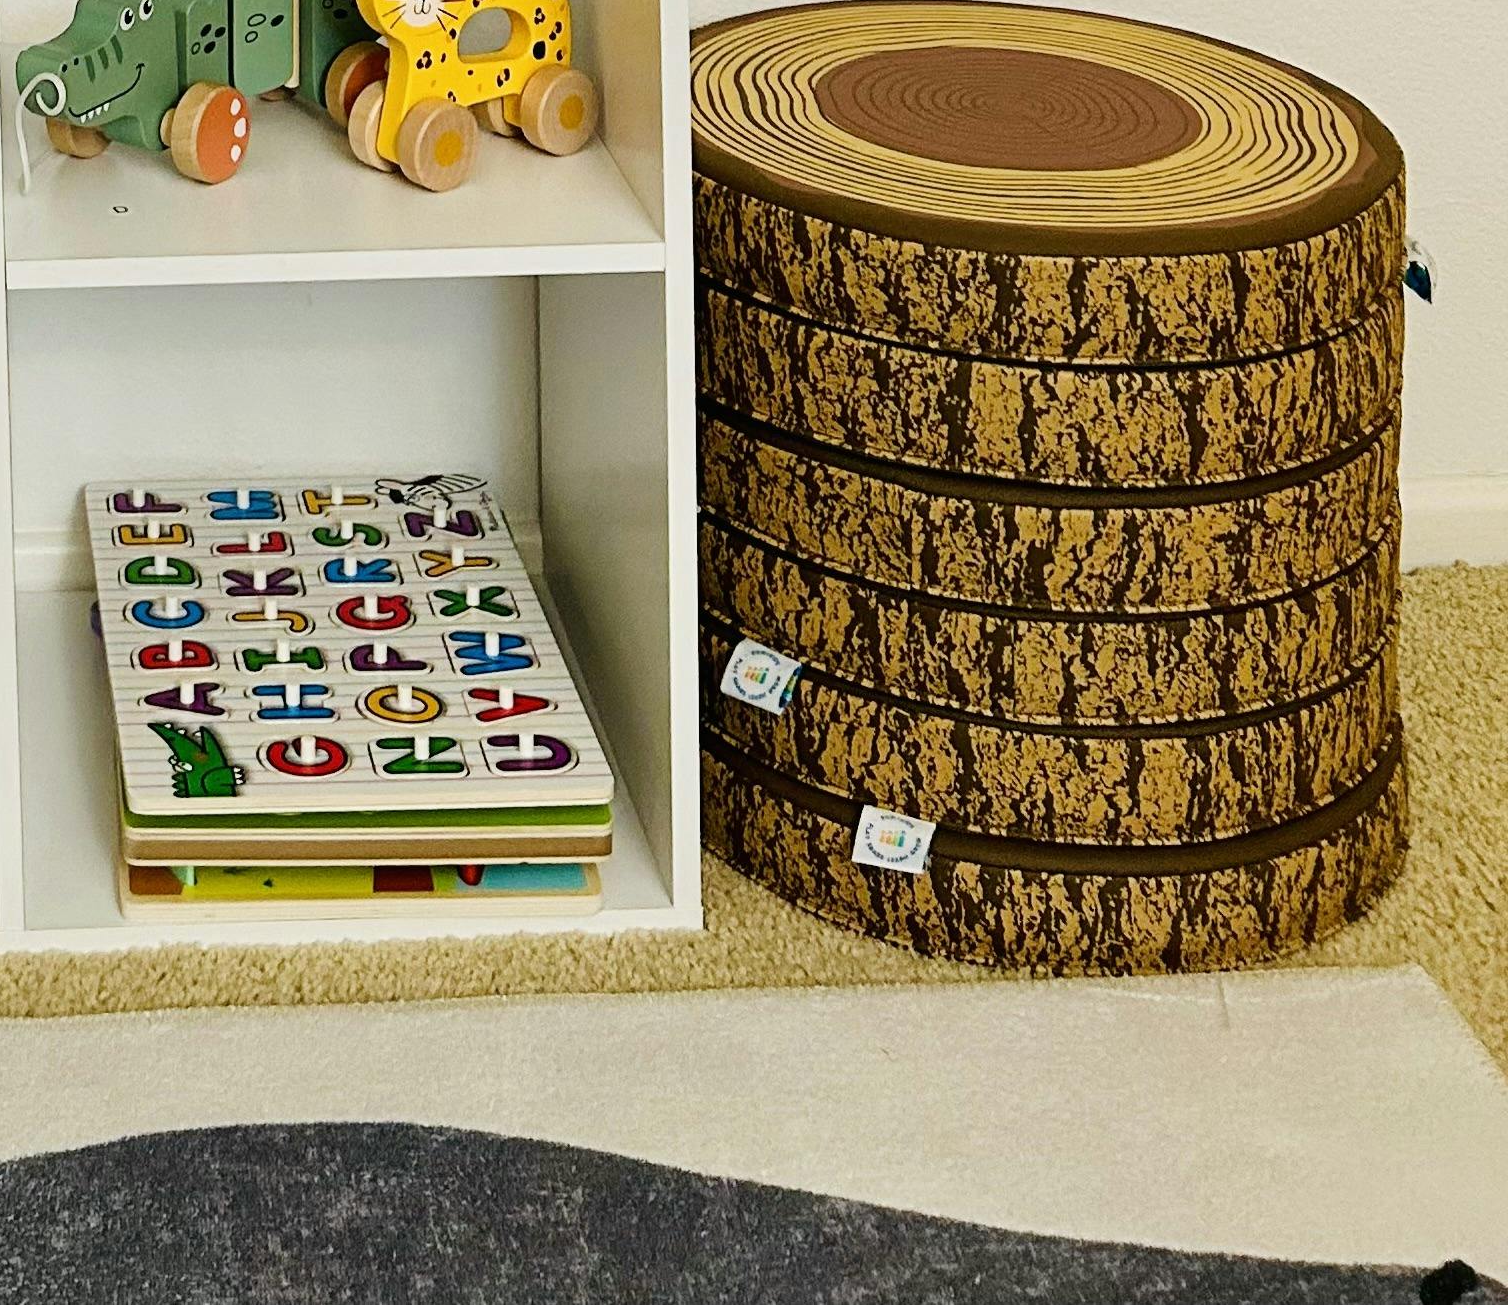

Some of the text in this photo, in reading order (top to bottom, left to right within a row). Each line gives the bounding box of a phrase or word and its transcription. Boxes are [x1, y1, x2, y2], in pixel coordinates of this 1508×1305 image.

[113, 493, 183, 514] F
[303, 491, 375, 514] T
[313, 522, 382, 548] S
[125, 556, 196, 586] D
[324, 557, 397, 583] R
[419, 549, 493, 577] Y
[132, 599, 205, 629] C
[434, 586, 514, 616] X
[207, 491, 349, 777] G H I J K L M
[350, 645, 427, 672] P
[447, 631, 533, 675] W
[143, 681, 225, 716] A
[467, 688, 550, 723] V
[375, 736, 462, 774] N
[487, 734, 571, 771] U
